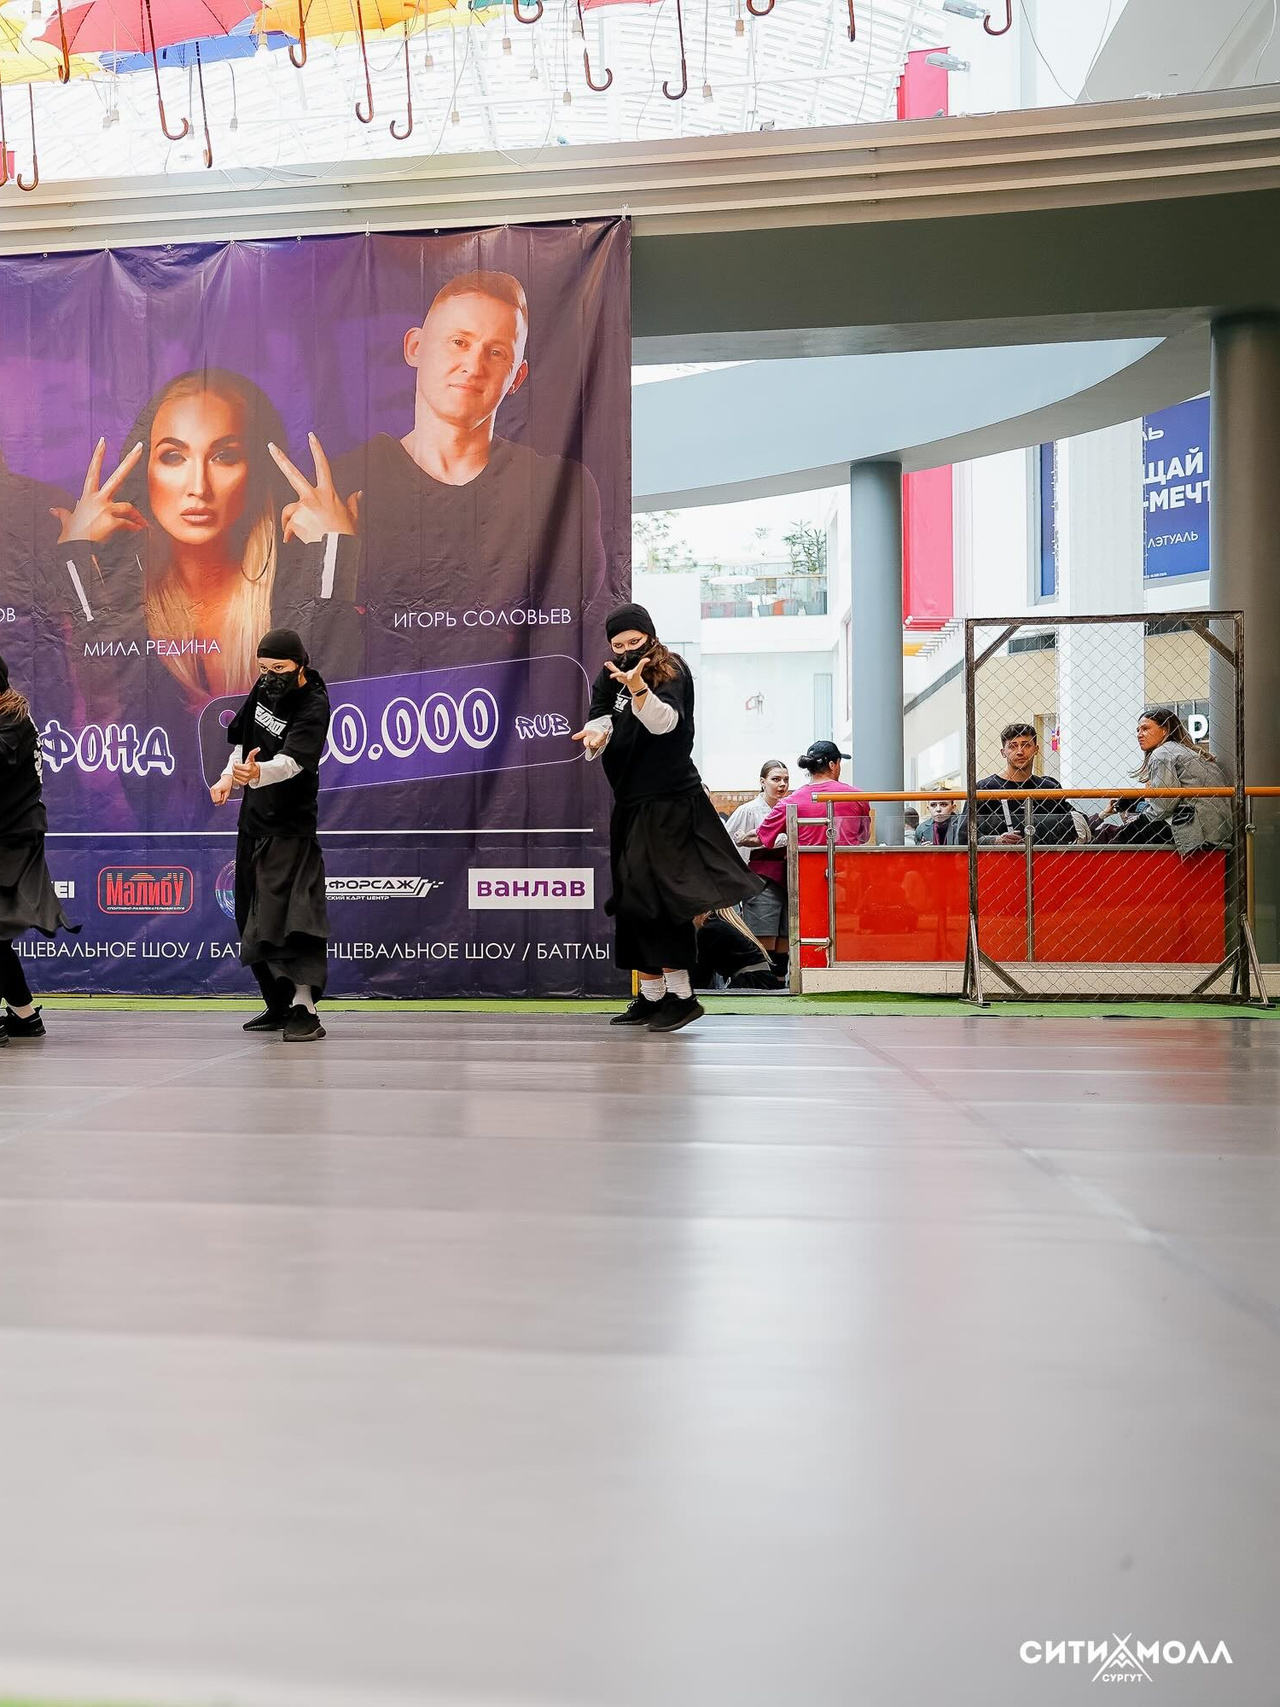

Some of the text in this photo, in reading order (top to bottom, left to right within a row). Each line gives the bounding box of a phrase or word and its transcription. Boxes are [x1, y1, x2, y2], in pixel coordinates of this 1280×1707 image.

[1148, 530, 1199, 549] ЛЭТУАЛЬ
[394, 608, 572, 629] ИГОРЬ СОЛОВЬЕВ
[83, 639, 222, 657] МИЛА РЕДИНА
[319, 687, 499, 766] 0.000
[515, 713, 571, 740] RUB
[38, 719, 176, 776] ФОНД
[106, 872, 185, 906] Малибу
[328, 880, 415, 890] ФОРСАЖ
[477, 878, 586, 898] ванлав
[142, 942, 190, 958] ШОУ
[465, 942, 516, 960] ШОУ
[537, 943, 610, 960] БАТТЛЫ
